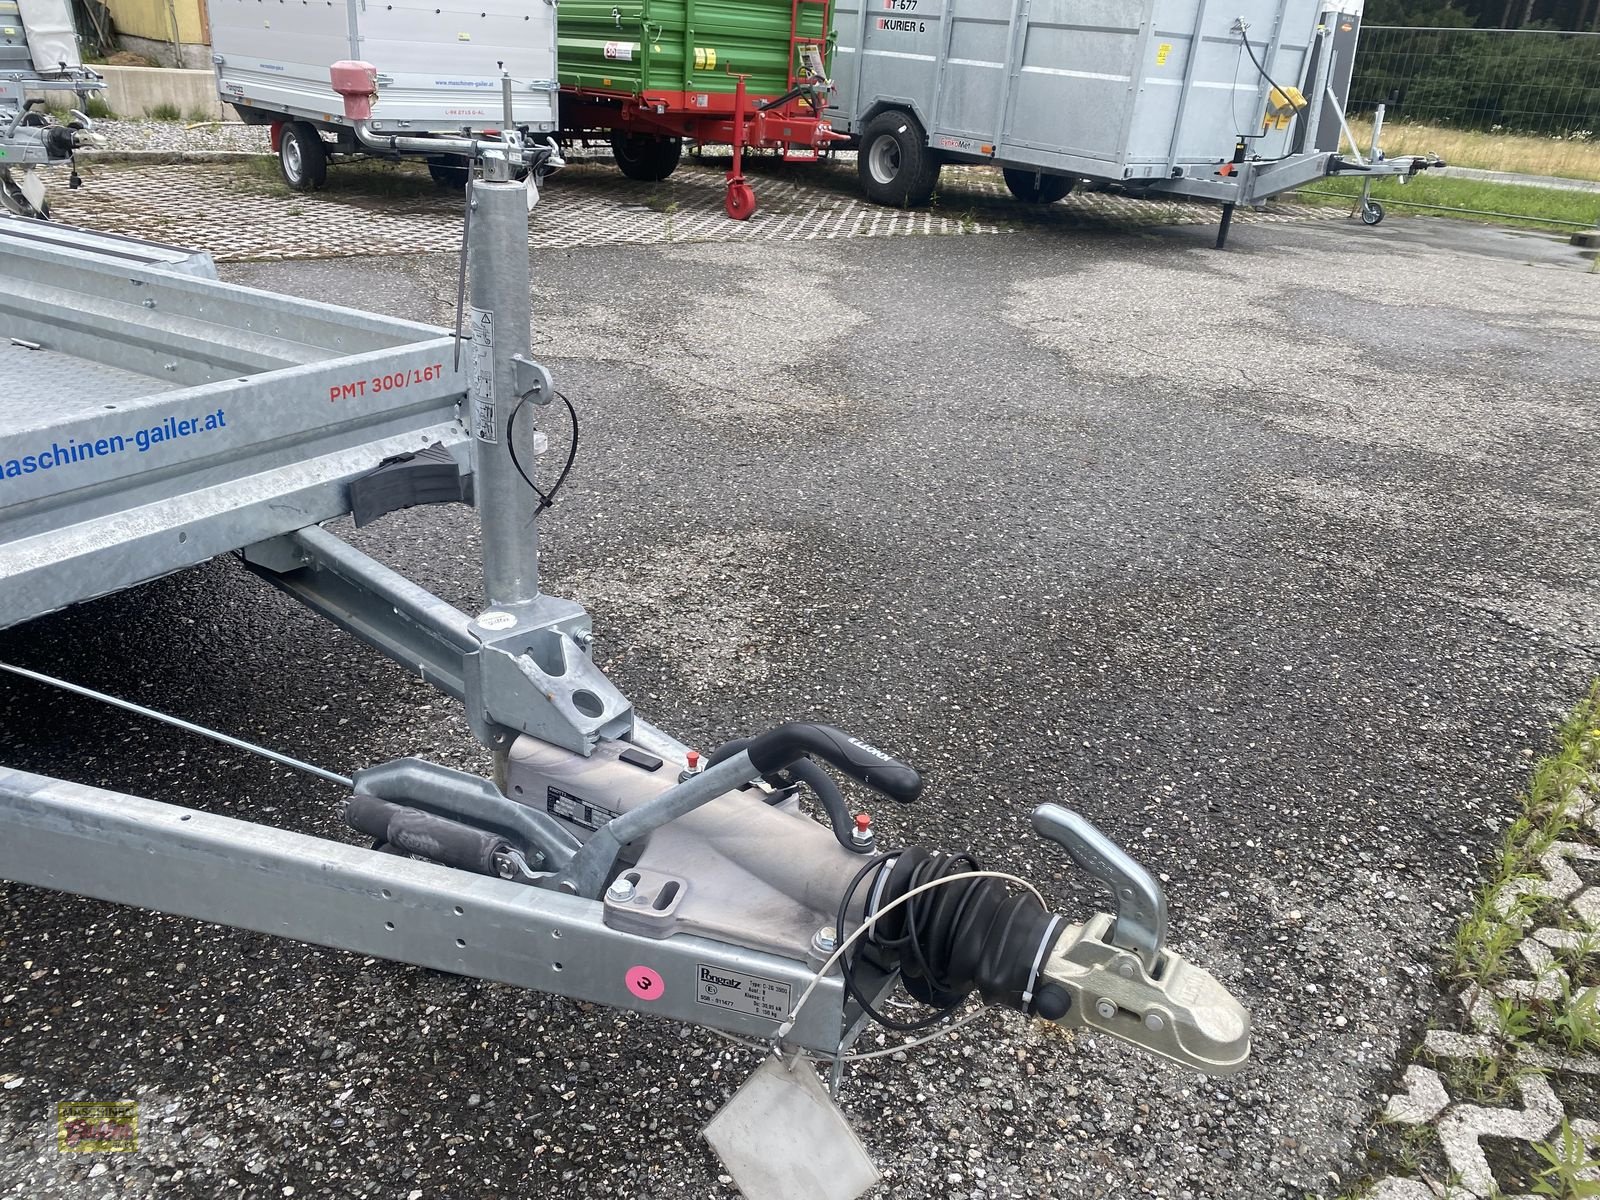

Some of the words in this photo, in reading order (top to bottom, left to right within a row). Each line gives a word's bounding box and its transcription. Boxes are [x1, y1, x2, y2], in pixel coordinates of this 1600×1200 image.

[892, 0, 917, 10] T-677
[883, 19, 916, 31] KURIER
[919, 22, 925, 33] 6
[330, 380, 367, 403] PMT
[372, 364, 442, 393] 300/16T
[637, 976, 652, 990] 3
[701, 967, 742, 989] Pongratz
